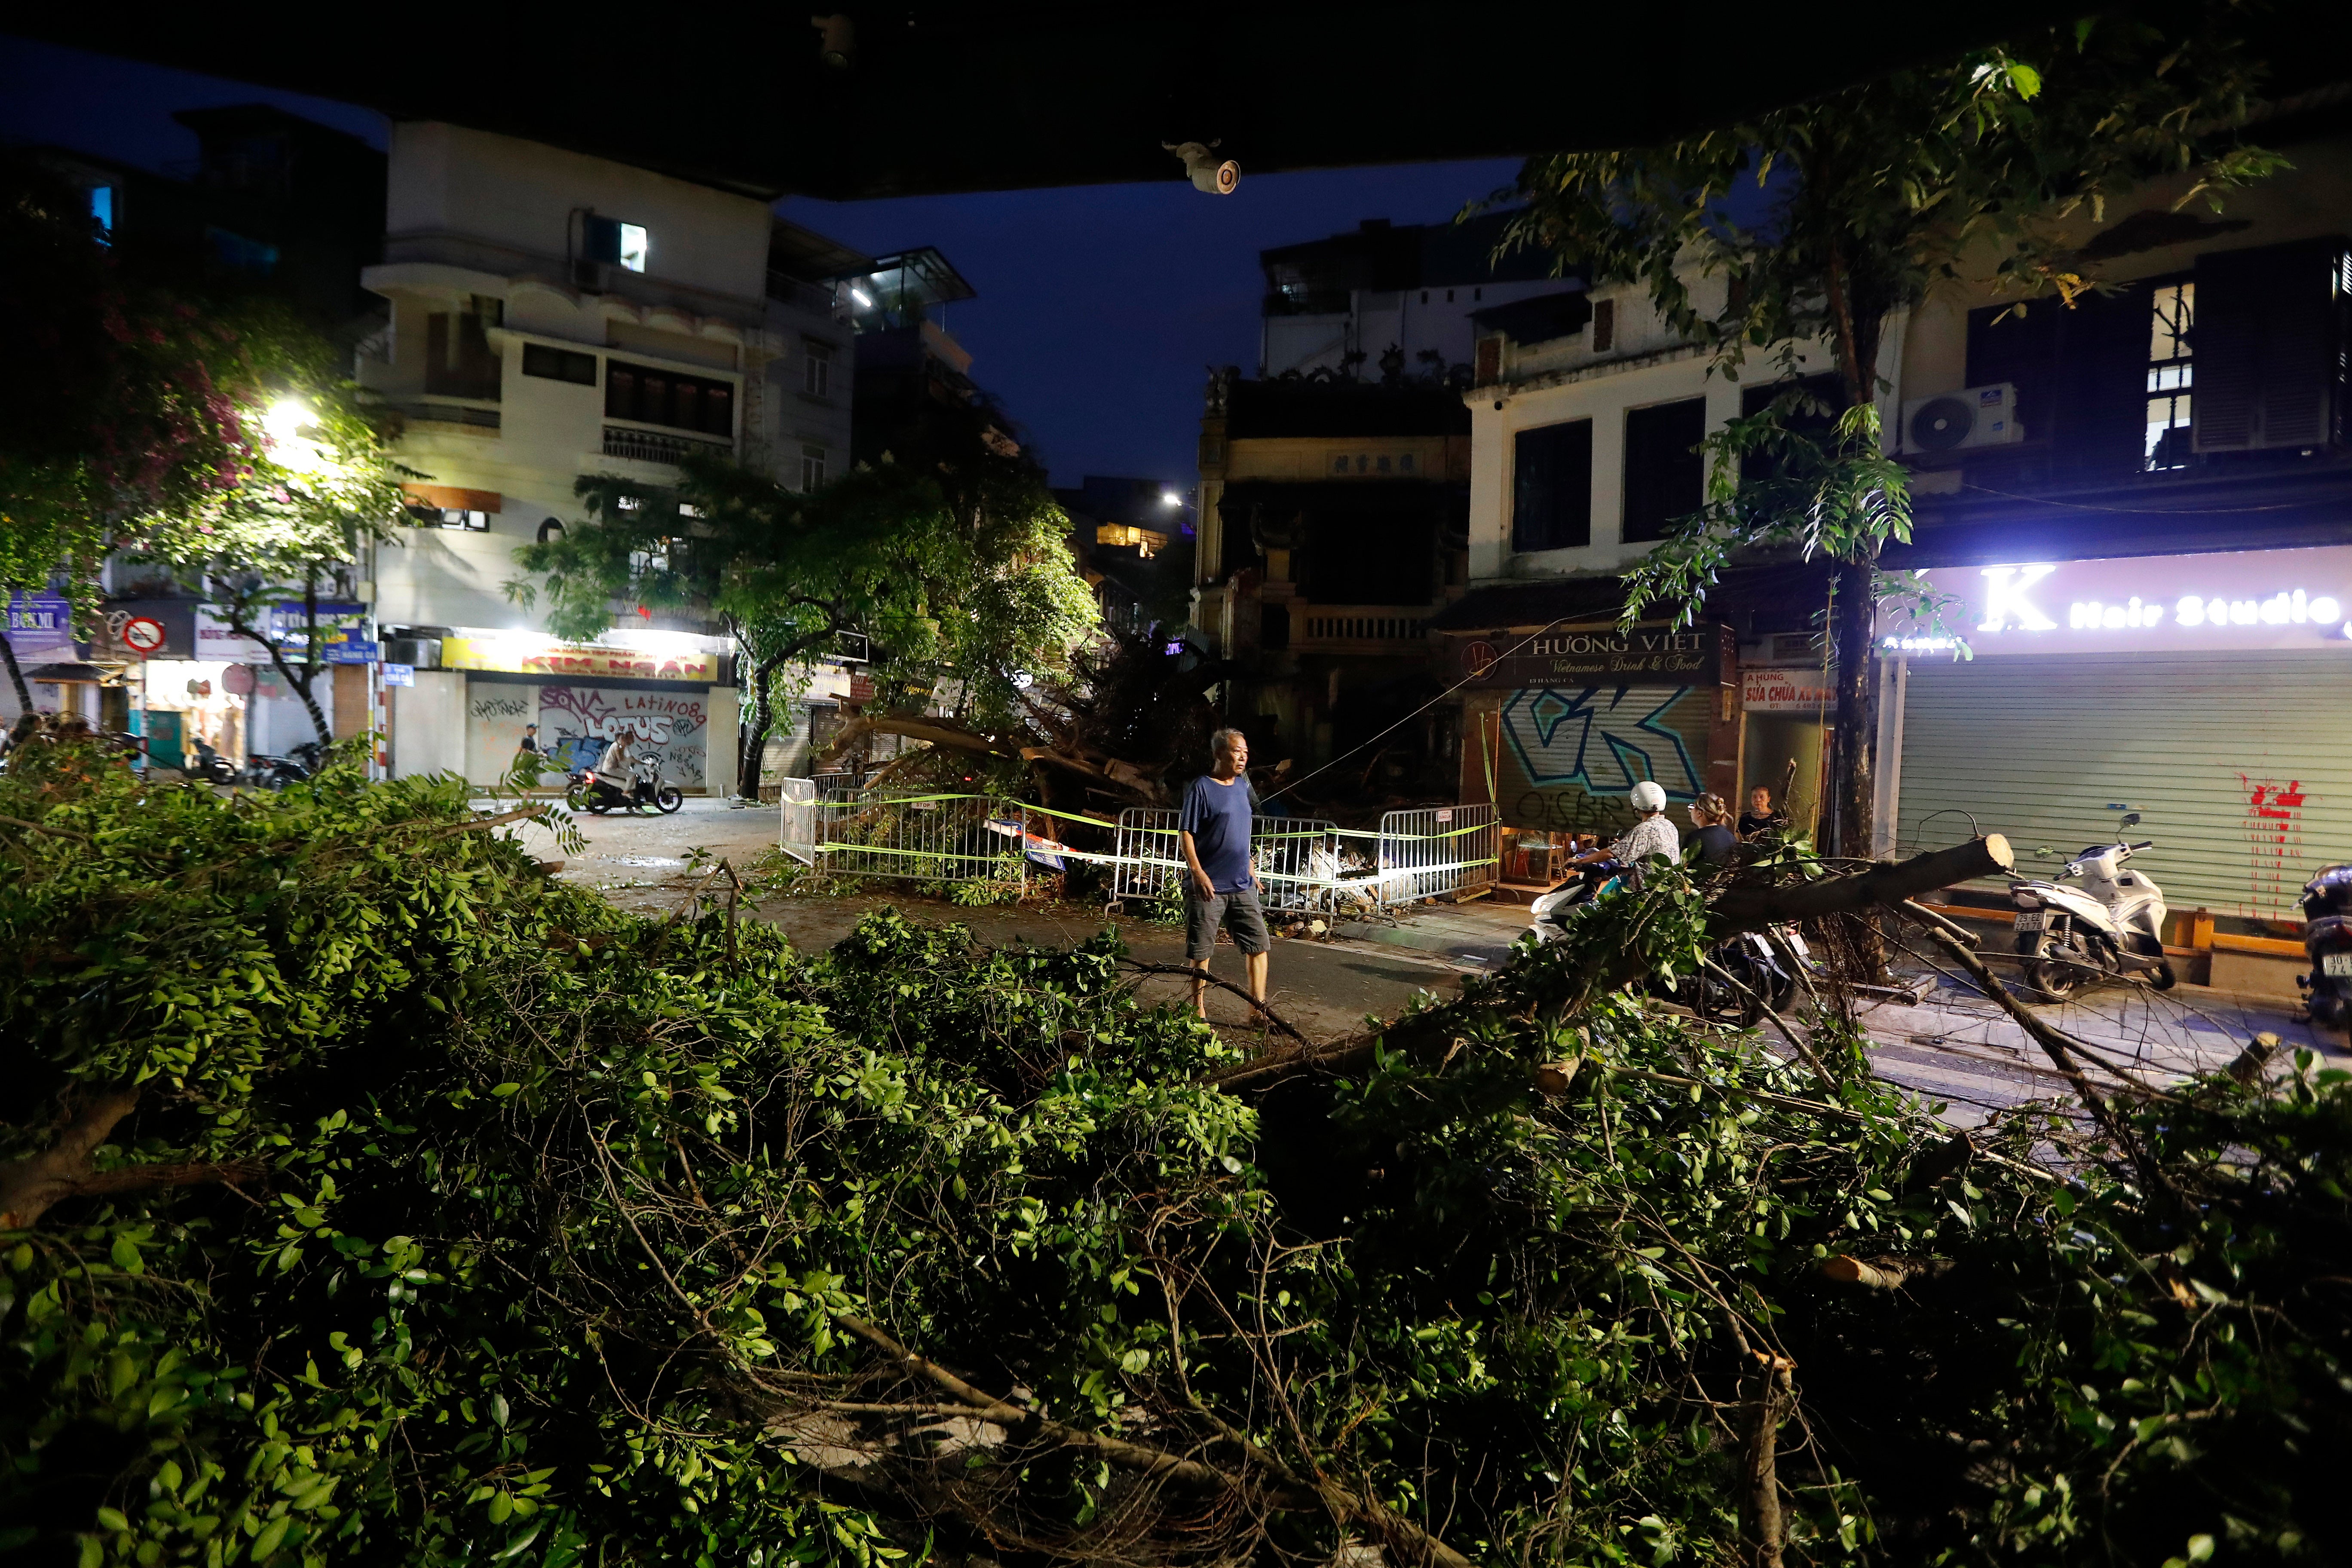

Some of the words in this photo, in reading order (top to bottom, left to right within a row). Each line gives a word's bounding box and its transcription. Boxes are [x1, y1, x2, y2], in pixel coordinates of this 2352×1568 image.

[1977, 564, 2058, 631] K
[2070, 597, 2164, 629] Hair
[2175, 588, 2341, 626] Studio
[1533, 635, 1629, 655] HƯƠNG
[1641, 633, 1706, 652] VIỆT
[1550, 658, 1605, 673] Vietnamese
[1610, 655, 1646, 672] Drink
[1648, 655, 1662, 671] &
[1665, 654, 1705, 671] Food
[584, 715, 674, 745] LOTUS
